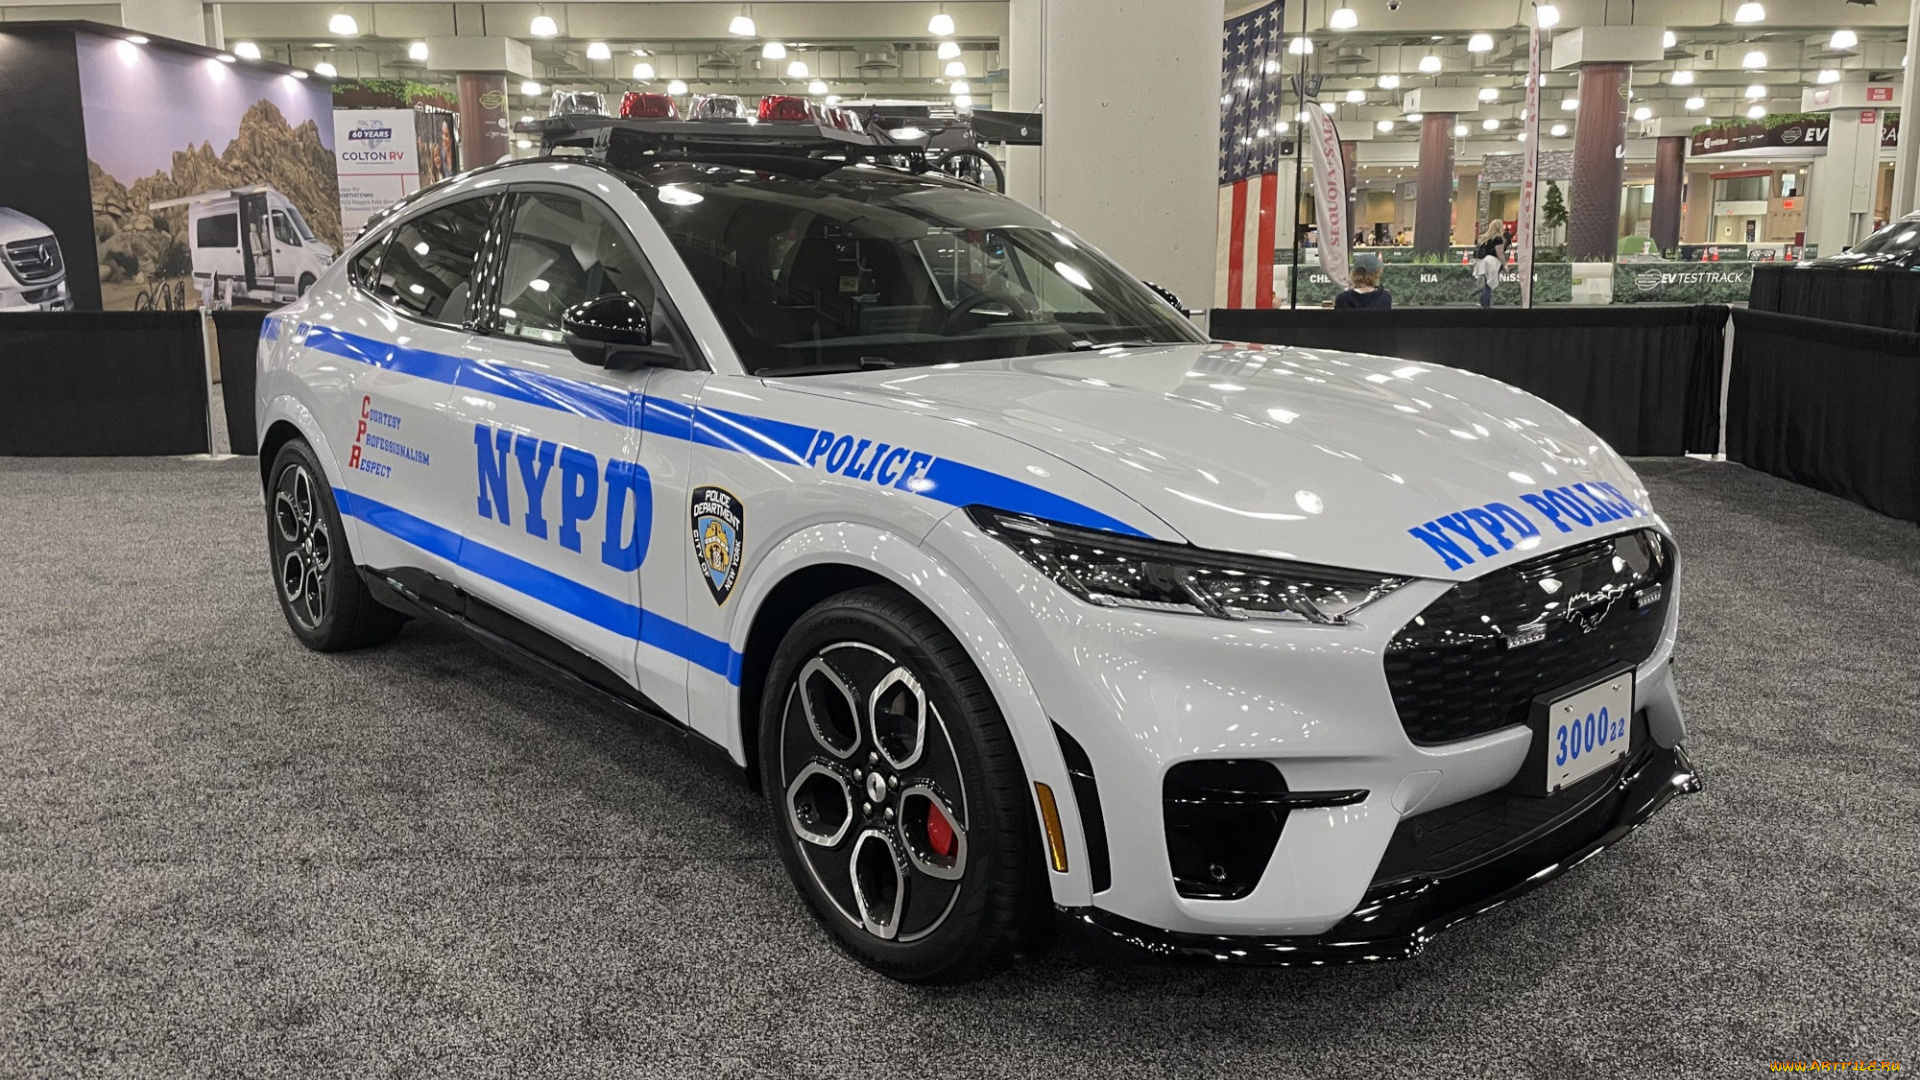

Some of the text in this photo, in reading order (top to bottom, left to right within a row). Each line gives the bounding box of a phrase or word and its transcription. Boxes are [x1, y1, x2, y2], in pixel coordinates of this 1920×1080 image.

[363, 130, 389, 138] YEARS
[1804, 127, 1828, 142] EV
[342, 151, 404, 161] COLTON RV
[1420, 274, 1438, 283] KIA
[1499, 273, 1538, 282] NISSN
[1661, 273, 1677, 284] EV
[1678, 273, 1707, 284] TEST
[1707, 272, 1743, 283] TRACK
[362, 395, 401, 430] COURTESY
[356, 419, 430, 466] PROFESSIONALISM
[348, 445, 392, 478] RESPECT
[806, 429, 934, 493] POLICE
[473, 422, 654, 573] NYPD
[705, 489, 731, 509] POLICE
[1518, 481, 1649, 533] POLICE
[693, 501, 741, 531] DEPARTMENT
[693, 529, 704, 558] CITY
[1407, 502, 1542, 571] NYPD
[724, 540, 742, 592] NEW YORK
[1556, 706, 1609, 767] 3000
